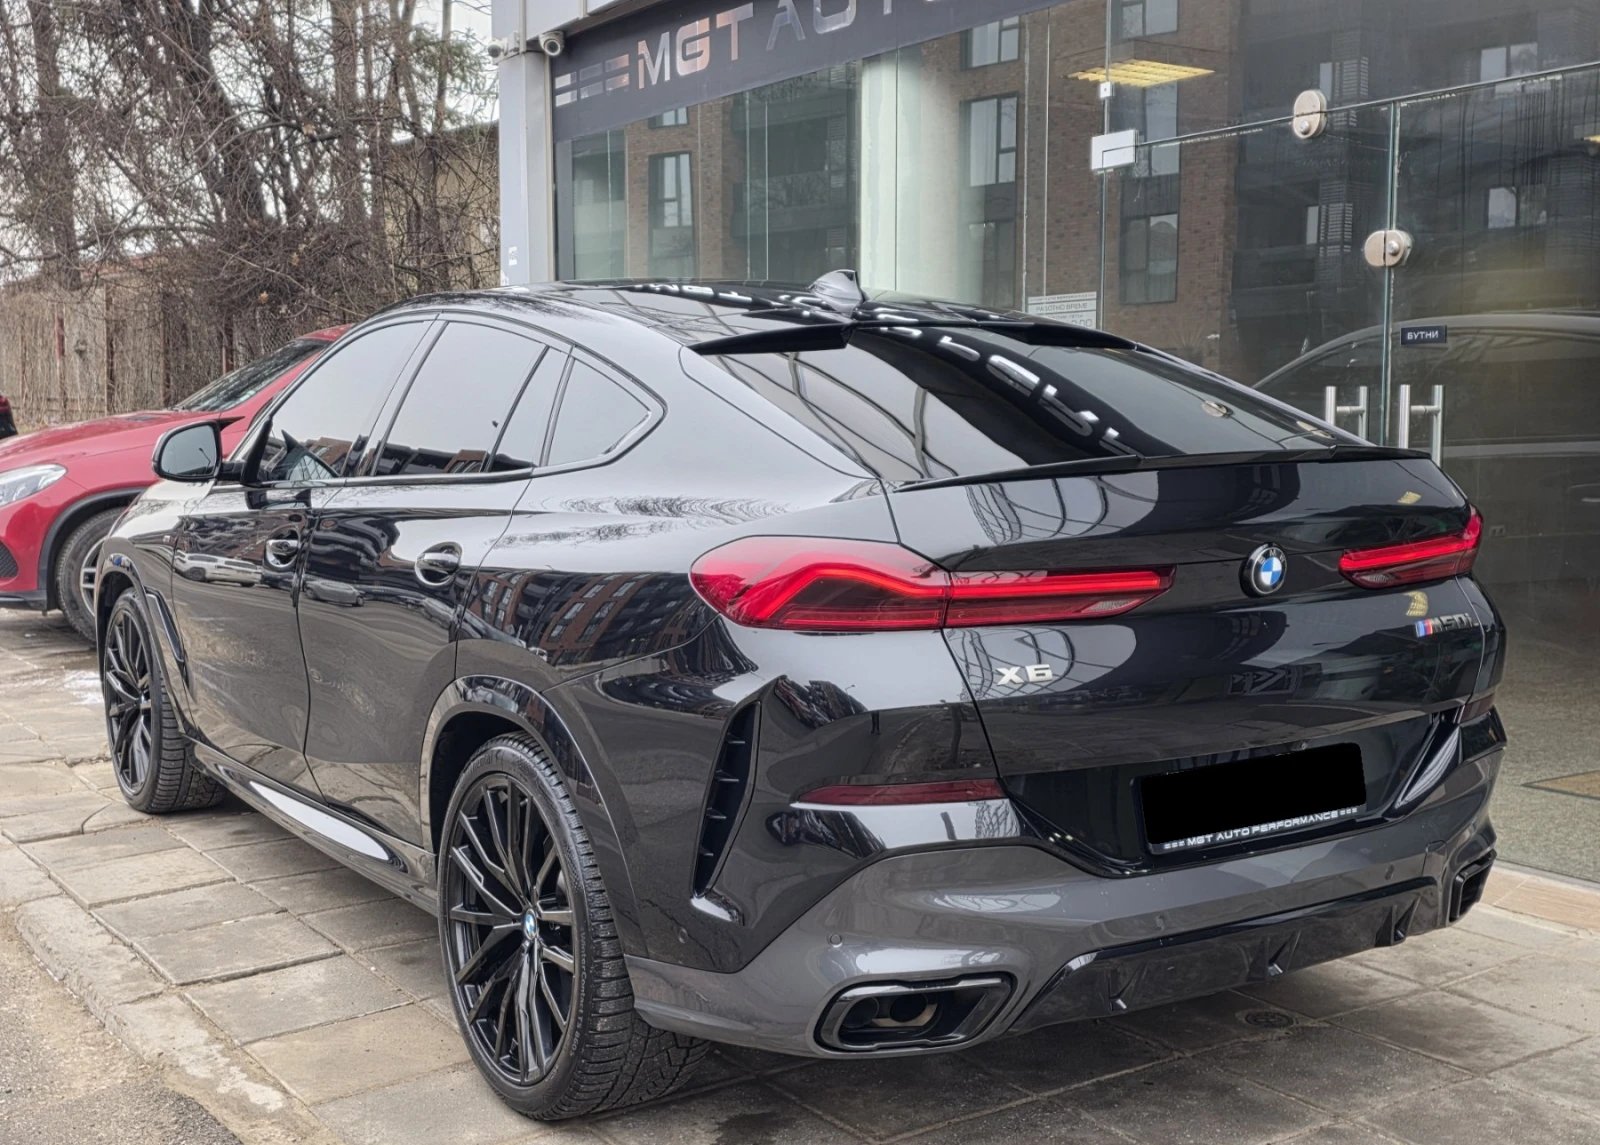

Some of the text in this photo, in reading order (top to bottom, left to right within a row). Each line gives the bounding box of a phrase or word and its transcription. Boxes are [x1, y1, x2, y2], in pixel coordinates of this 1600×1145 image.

[638, 2, 753, 89] MGT
[1407, 330, 1439, 340] БУТНИ
[995, 664, 1053, 687] X6
[1187, 810, 1339, 846] MGT AUTO PERFORMANCE
